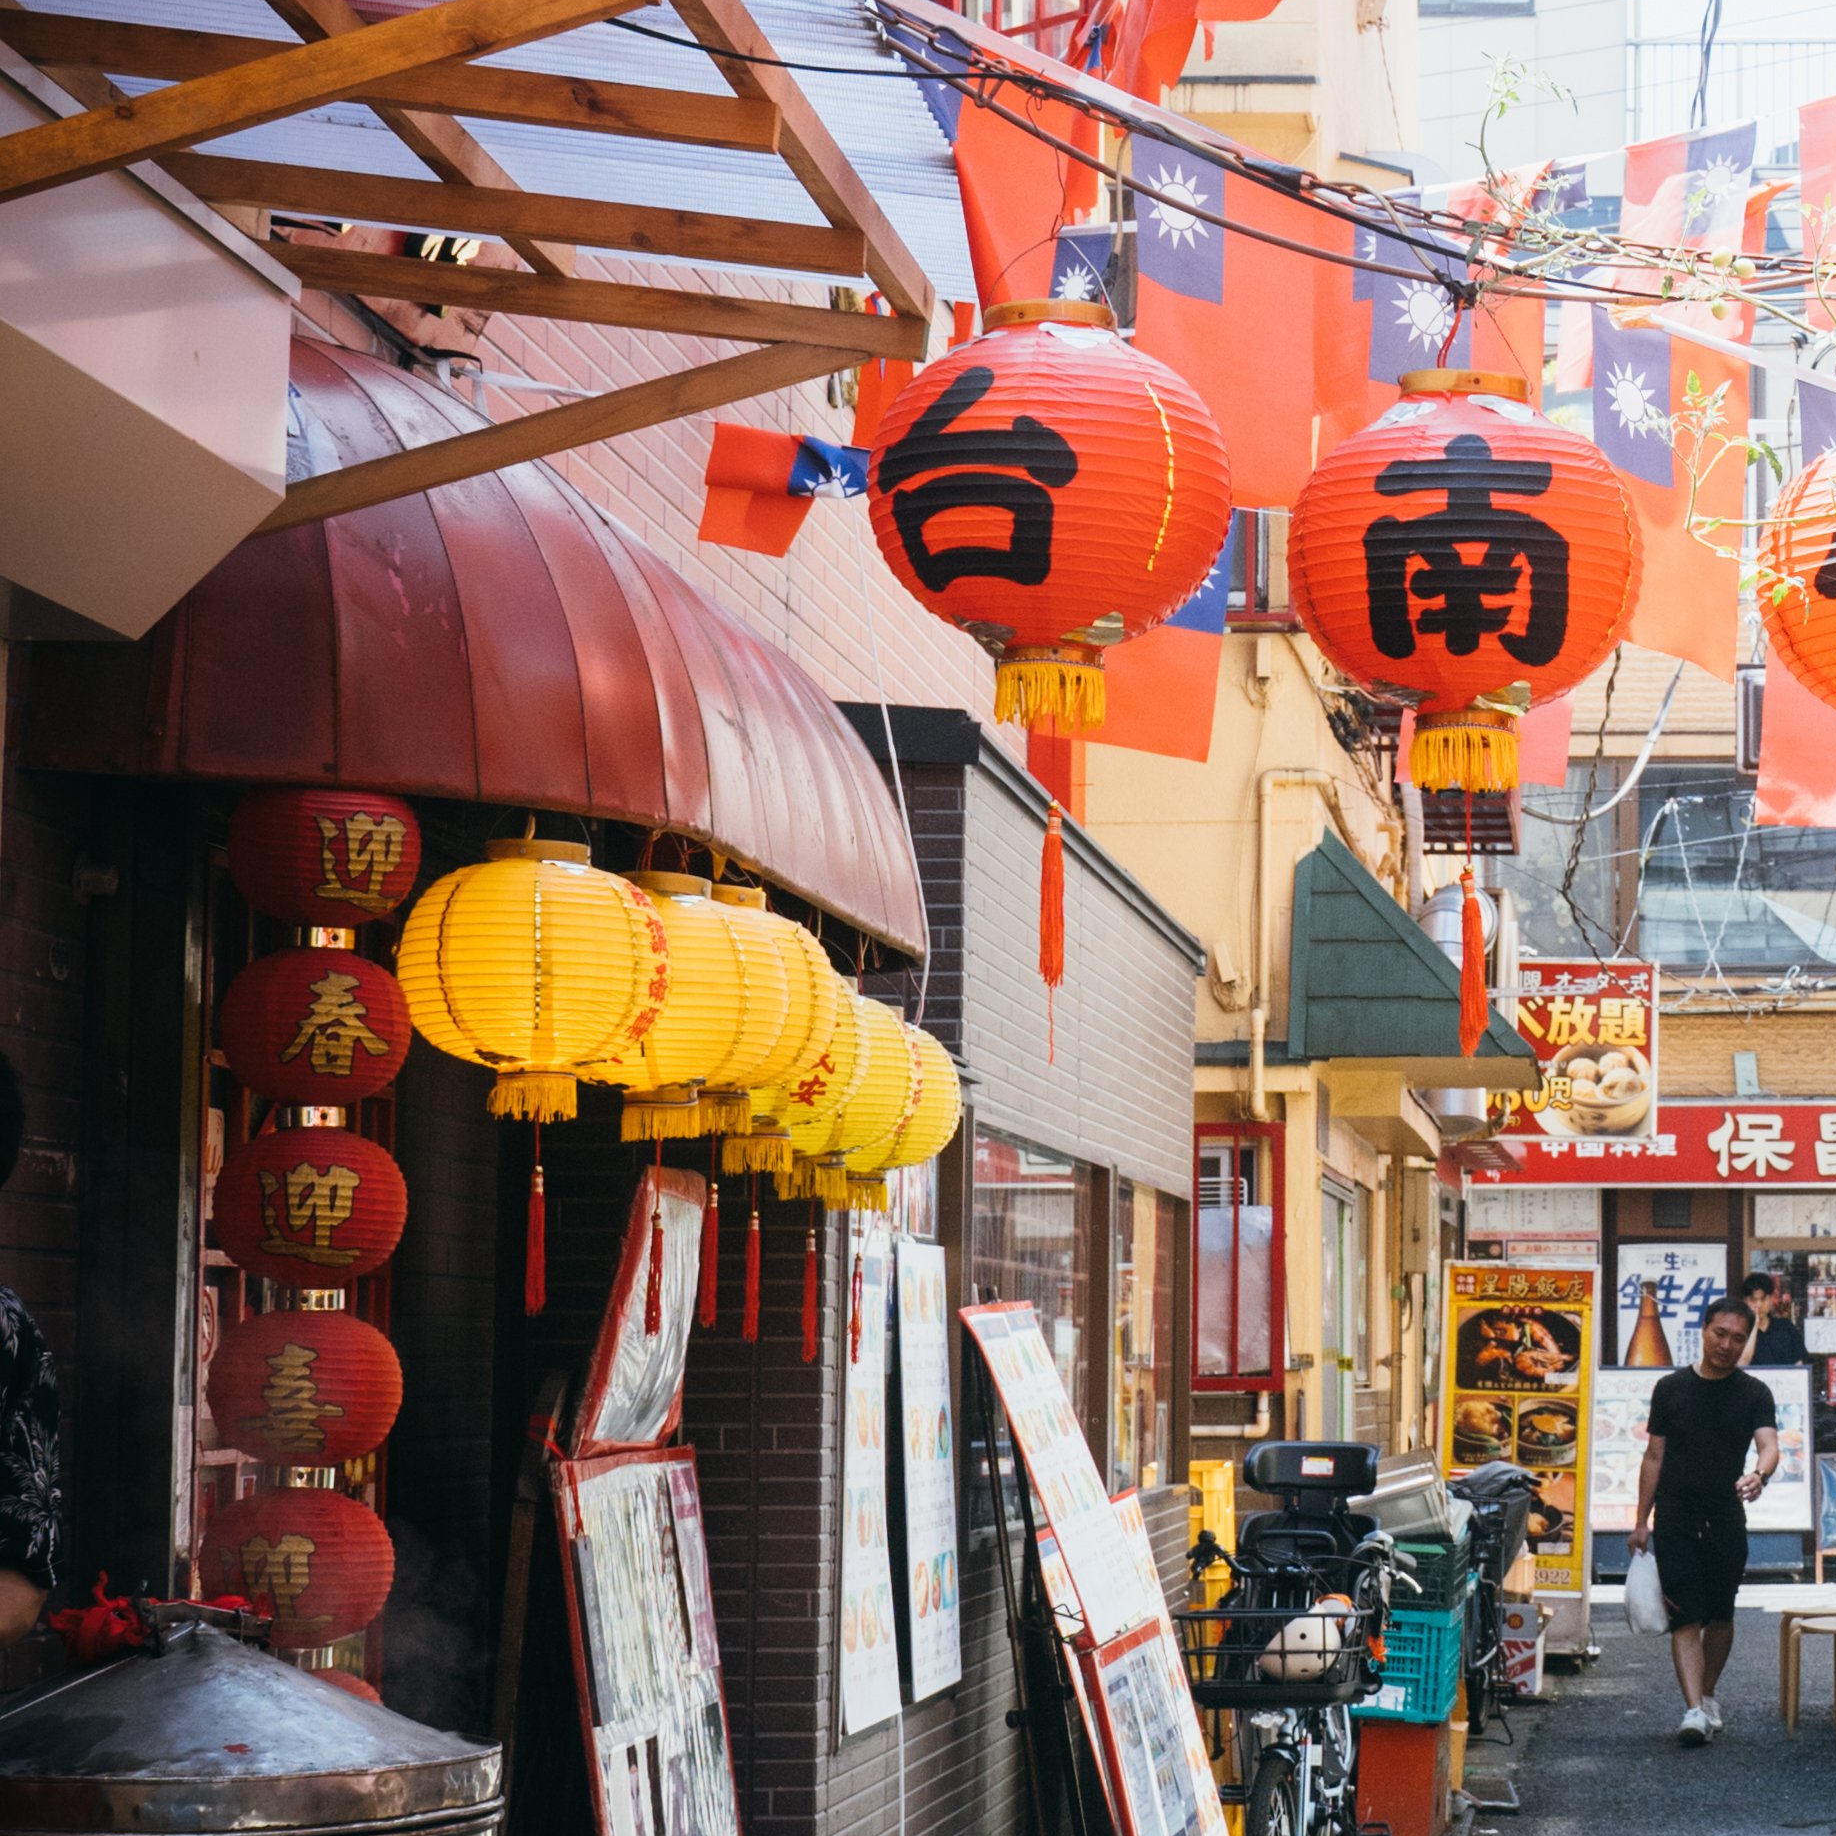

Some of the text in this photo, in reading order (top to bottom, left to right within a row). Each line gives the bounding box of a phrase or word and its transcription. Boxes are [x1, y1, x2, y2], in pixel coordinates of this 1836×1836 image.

[878, 366, 1078, 592] 台
[1364, 434, 1570, 667] 南
[281, 969, 391, 1075] 春
